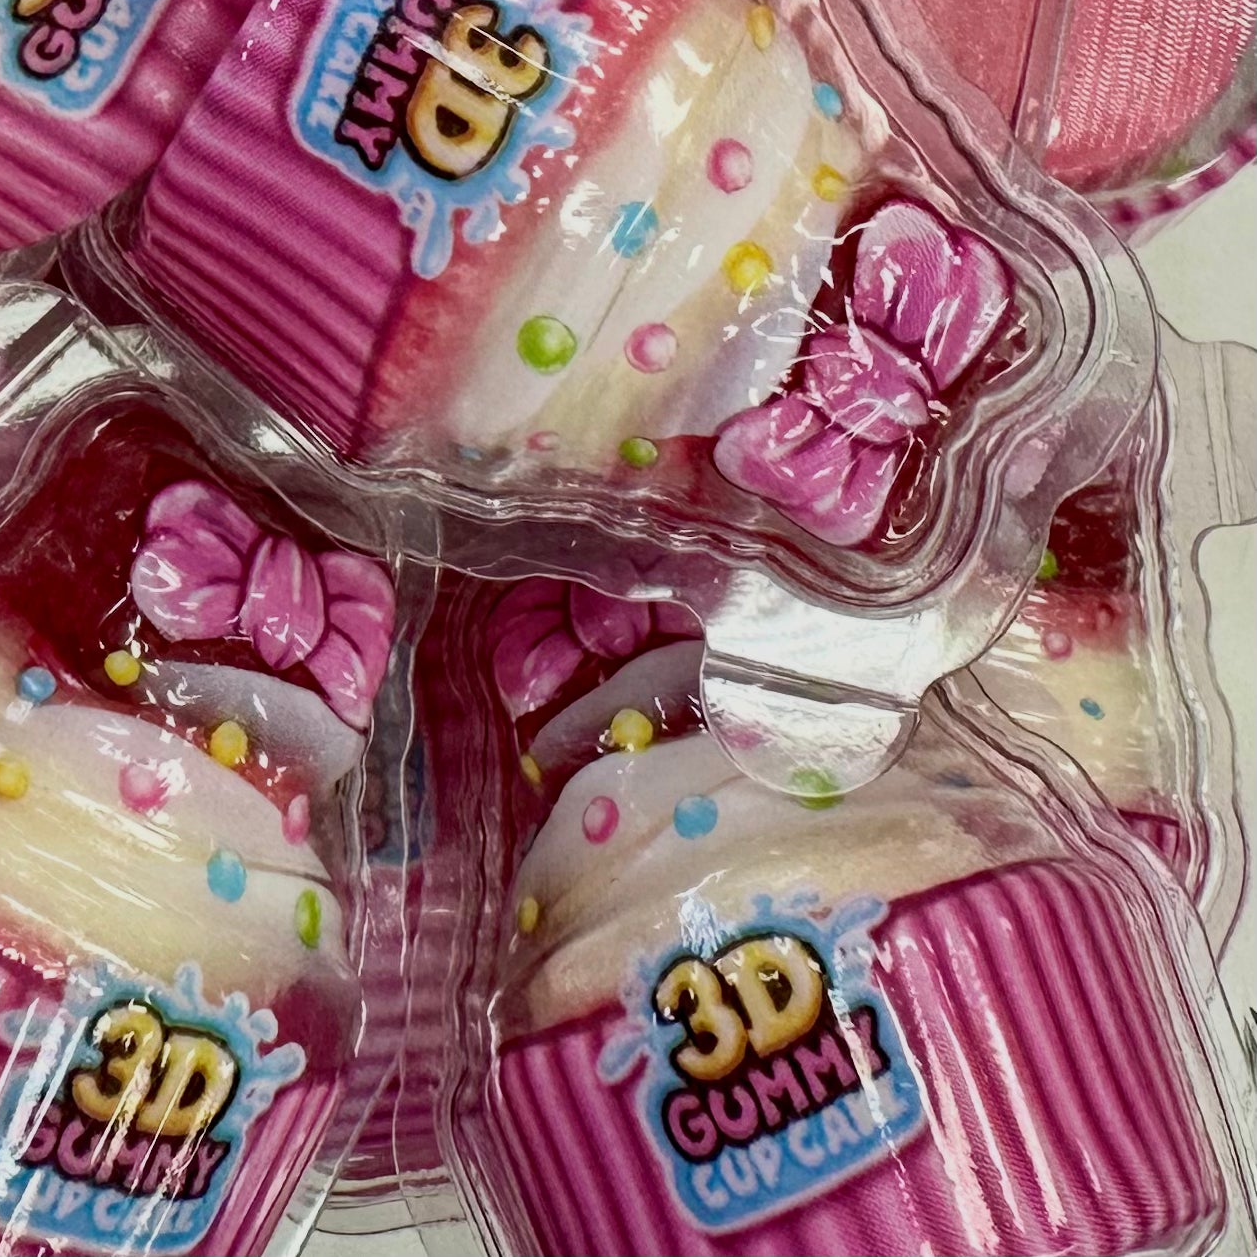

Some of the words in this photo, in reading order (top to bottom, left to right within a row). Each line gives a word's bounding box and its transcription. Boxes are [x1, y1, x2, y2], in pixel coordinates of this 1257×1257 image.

[403, 0, 550, 180] 3D
[66, 1000, 242, 1139] 3D
[652, 932, 833, 1083] 3D
[661, 1004, 890, 1166] GUMMY
